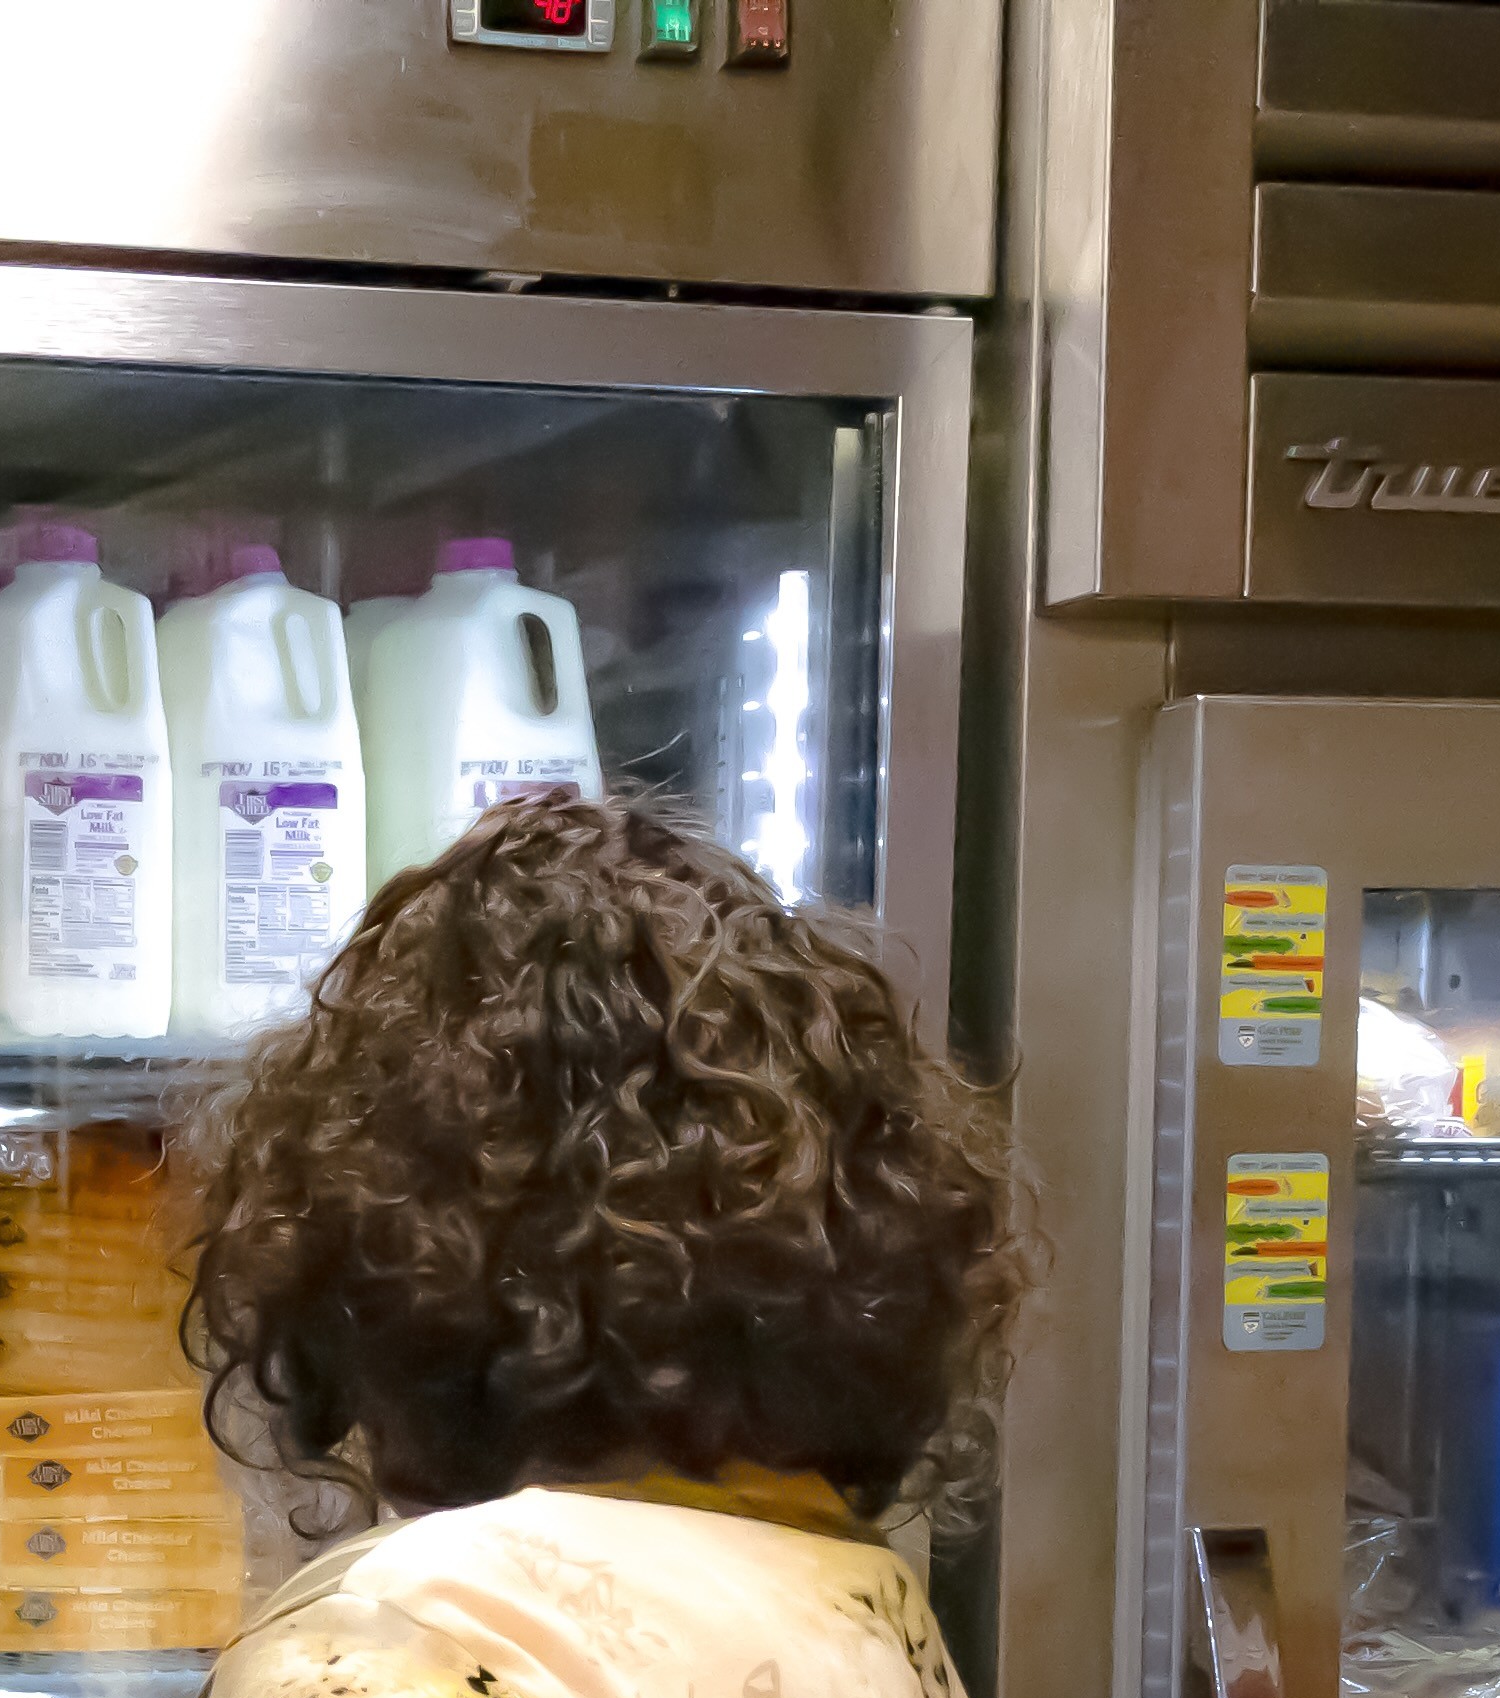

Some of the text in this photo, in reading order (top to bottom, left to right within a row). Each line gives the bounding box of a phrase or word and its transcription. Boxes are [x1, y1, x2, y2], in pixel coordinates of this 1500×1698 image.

[276, 817, 320, 829] Low Fat
[285, 830, 310, 841] Milk
